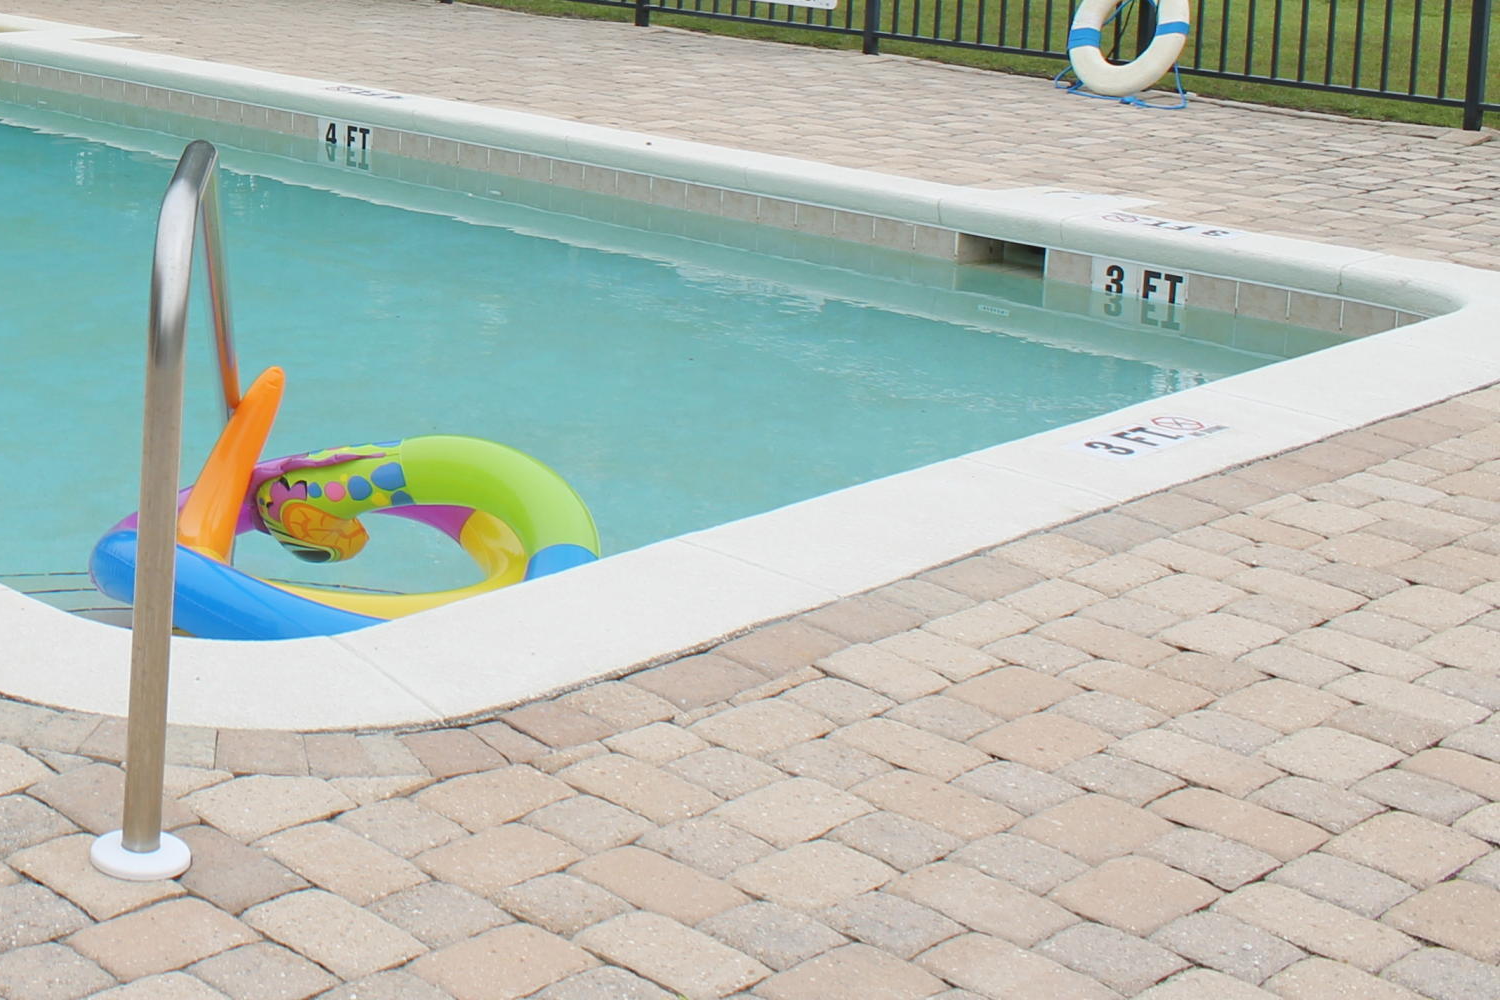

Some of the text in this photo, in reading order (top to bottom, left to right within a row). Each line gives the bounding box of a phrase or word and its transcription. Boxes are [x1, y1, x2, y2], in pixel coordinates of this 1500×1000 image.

[325, 123, 370, 150] 4 FT
[1105, 265, 1183, 304] 3 FT
[1084, 441, 1135, 455] 3
